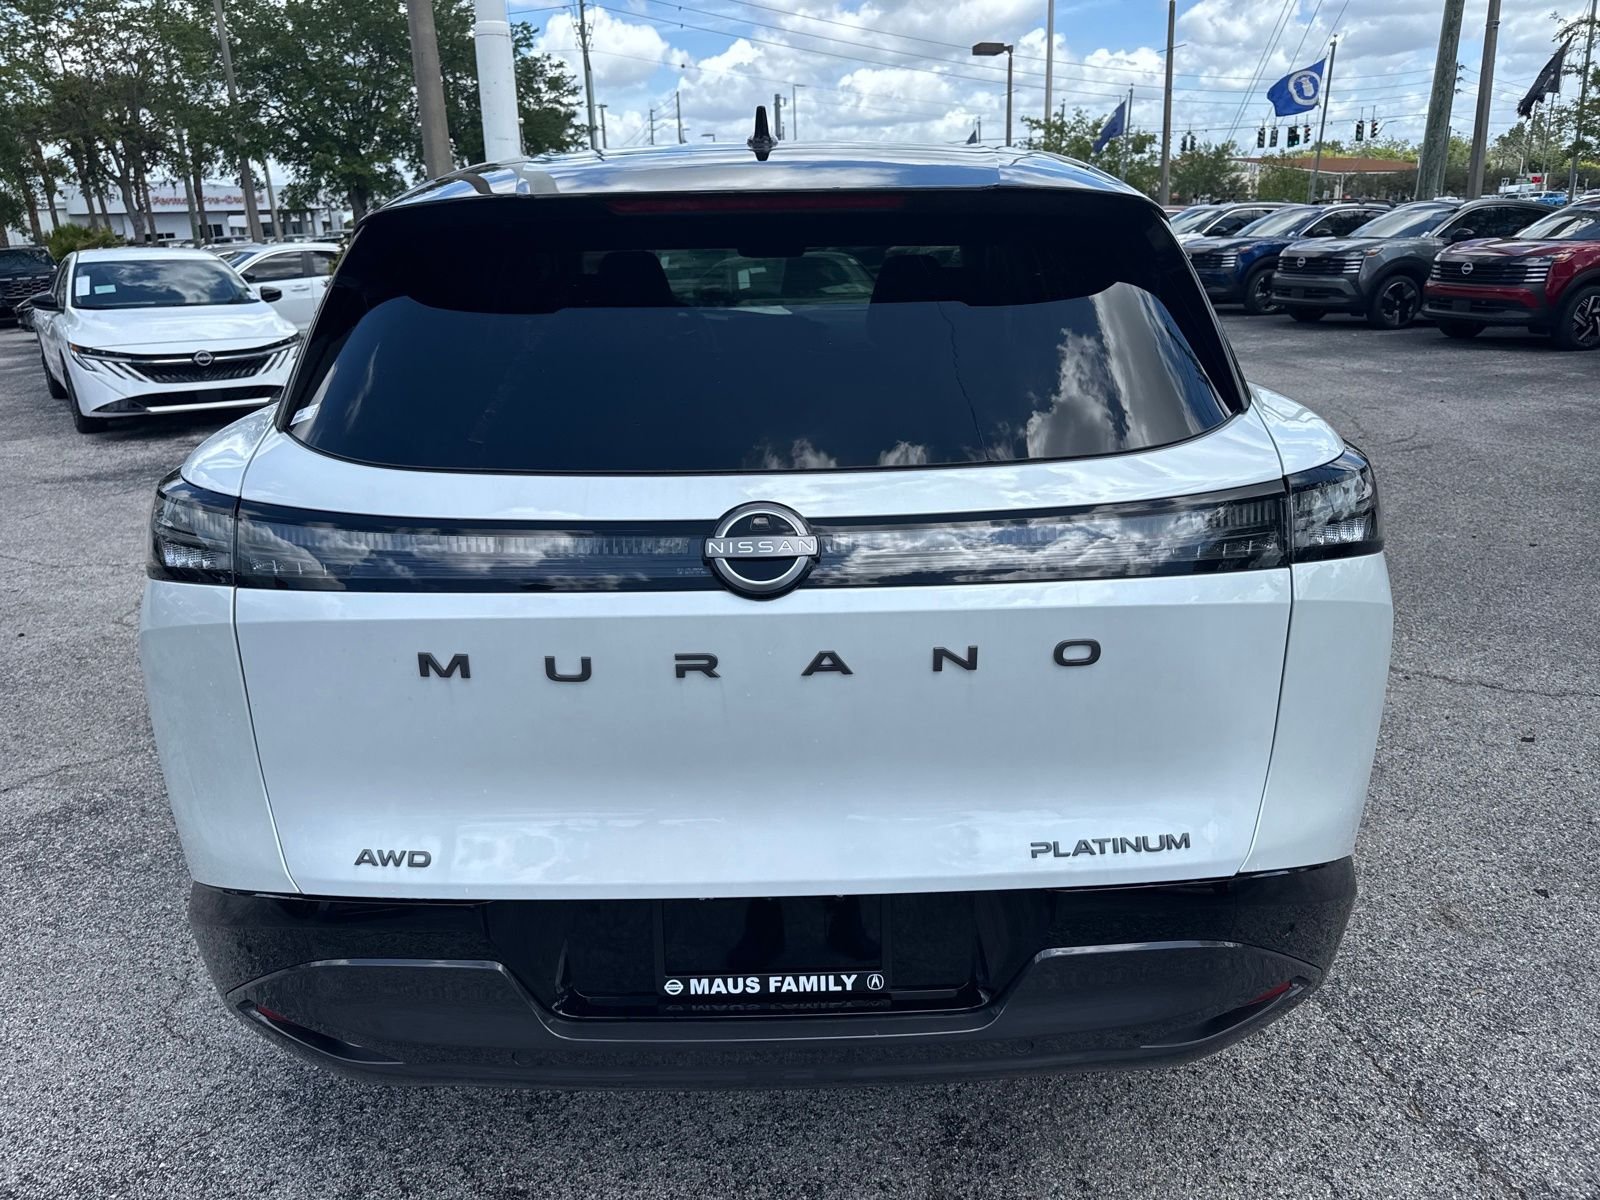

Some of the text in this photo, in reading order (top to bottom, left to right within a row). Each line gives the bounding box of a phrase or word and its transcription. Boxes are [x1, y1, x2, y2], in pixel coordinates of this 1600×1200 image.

[708, 539, 815, 554] NISSAN
[417, 638, 1102, 682] MURANO
[1030, 832, 1191, 859] PLATINUM
[354, 848, 432, 868] AWD
[689, 974, 858, 995] MAUS FAMILY
